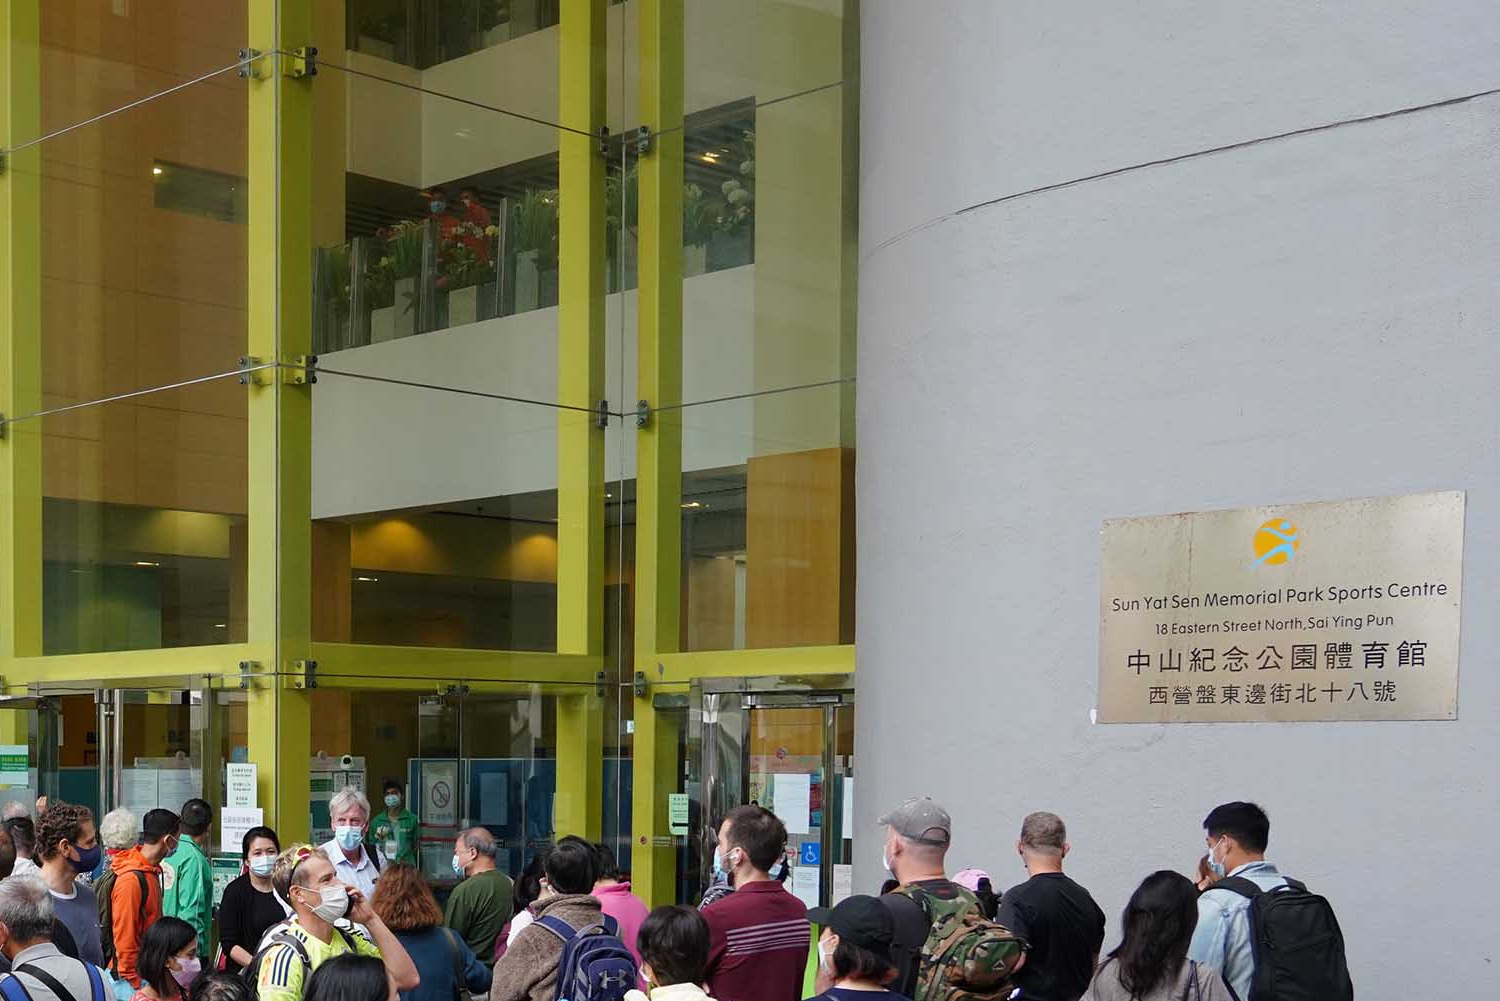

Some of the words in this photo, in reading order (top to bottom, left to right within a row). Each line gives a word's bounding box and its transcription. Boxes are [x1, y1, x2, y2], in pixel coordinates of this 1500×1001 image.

[1112, 598, 1140, 612] Sun
[1143, 596, 1168, 610] Yat
[1171, 594, 1200, 609] Sen
[1204, 588, 1282, 607] Memorial
[1286, 586, 1324, 603] Park
[1328, 584, 1383, 604] Sports
[1387, 582, 1447, 598] Centre
[1155, 623, 1168, 635] 18
[1171, 622, 1220, 635] Eastern
[1222, 619, 1261, 633] Street
[1332, 615, 1363, 631] Ying
[1366, 614, 1394, 627] Pun
[1127, 639, 1427, 675] 中山紀念公園體育館
[1148, 679, 1397, 706] 西營盤東邊街北十八號
